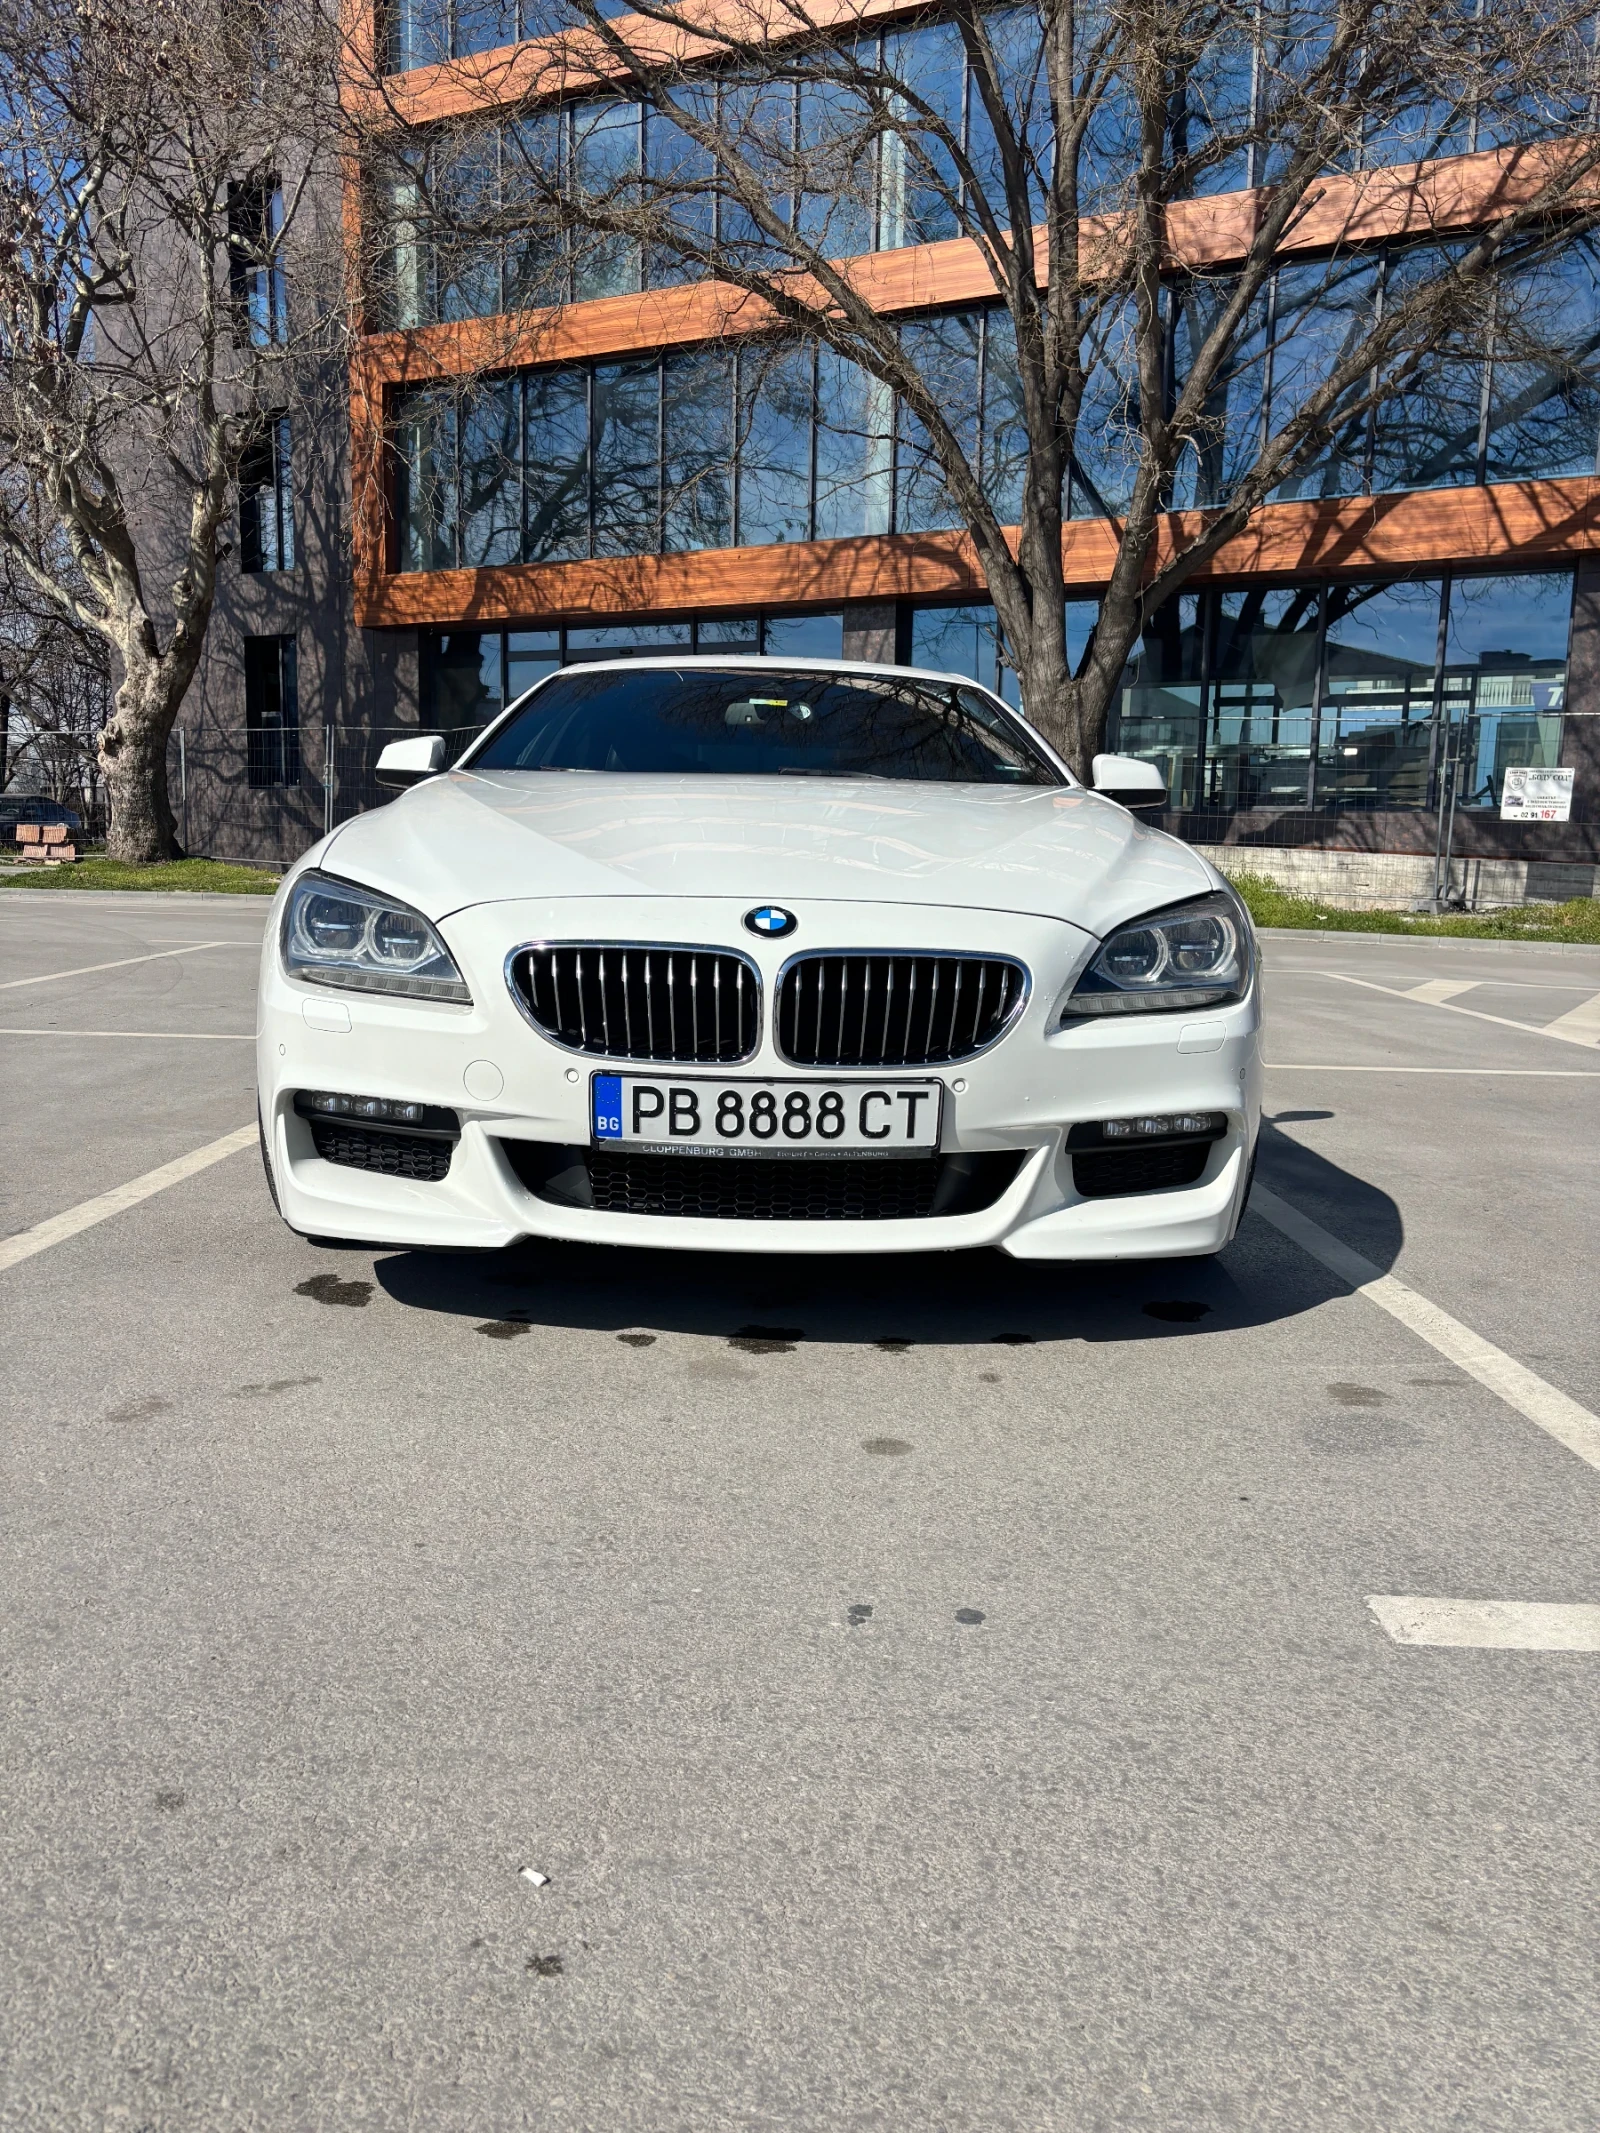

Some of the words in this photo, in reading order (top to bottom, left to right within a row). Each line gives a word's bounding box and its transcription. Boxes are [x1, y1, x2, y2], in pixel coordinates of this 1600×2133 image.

[1540, 809, 1557, 819] 167
[632, 1085, 701, 1136] PB
[715, 1089, 846, 1140] 8888
[859, 1090, 930, 1140] CT
[597, 1115, 620, 1132] BG
[642, 1144, 725, 1157] CLOPPENBURG
